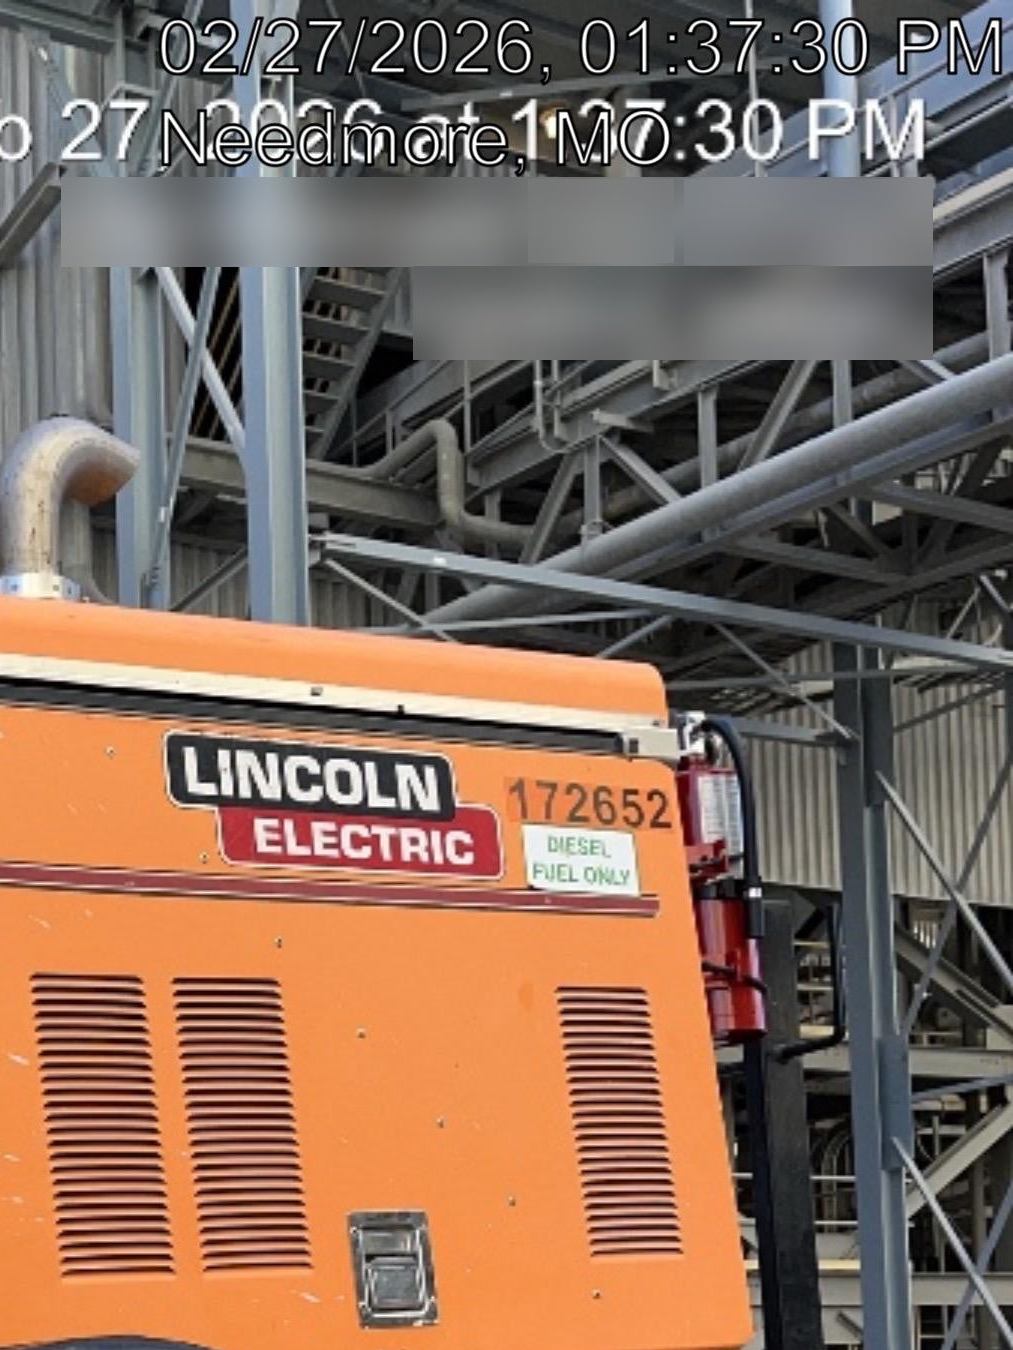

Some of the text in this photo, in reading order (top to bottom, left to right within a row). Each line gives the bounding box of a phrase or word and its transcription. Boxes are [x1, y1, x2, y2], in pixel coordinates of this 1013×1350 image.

[182, 745, 442, 812] LINCOLN
[508, 778, 673, 830] 172652
[253, 816, 476, 866] ELECTRIC
[547, 834, 613, 859] DIESEL
[531, 861, 631, 887] FUEL ONLY
